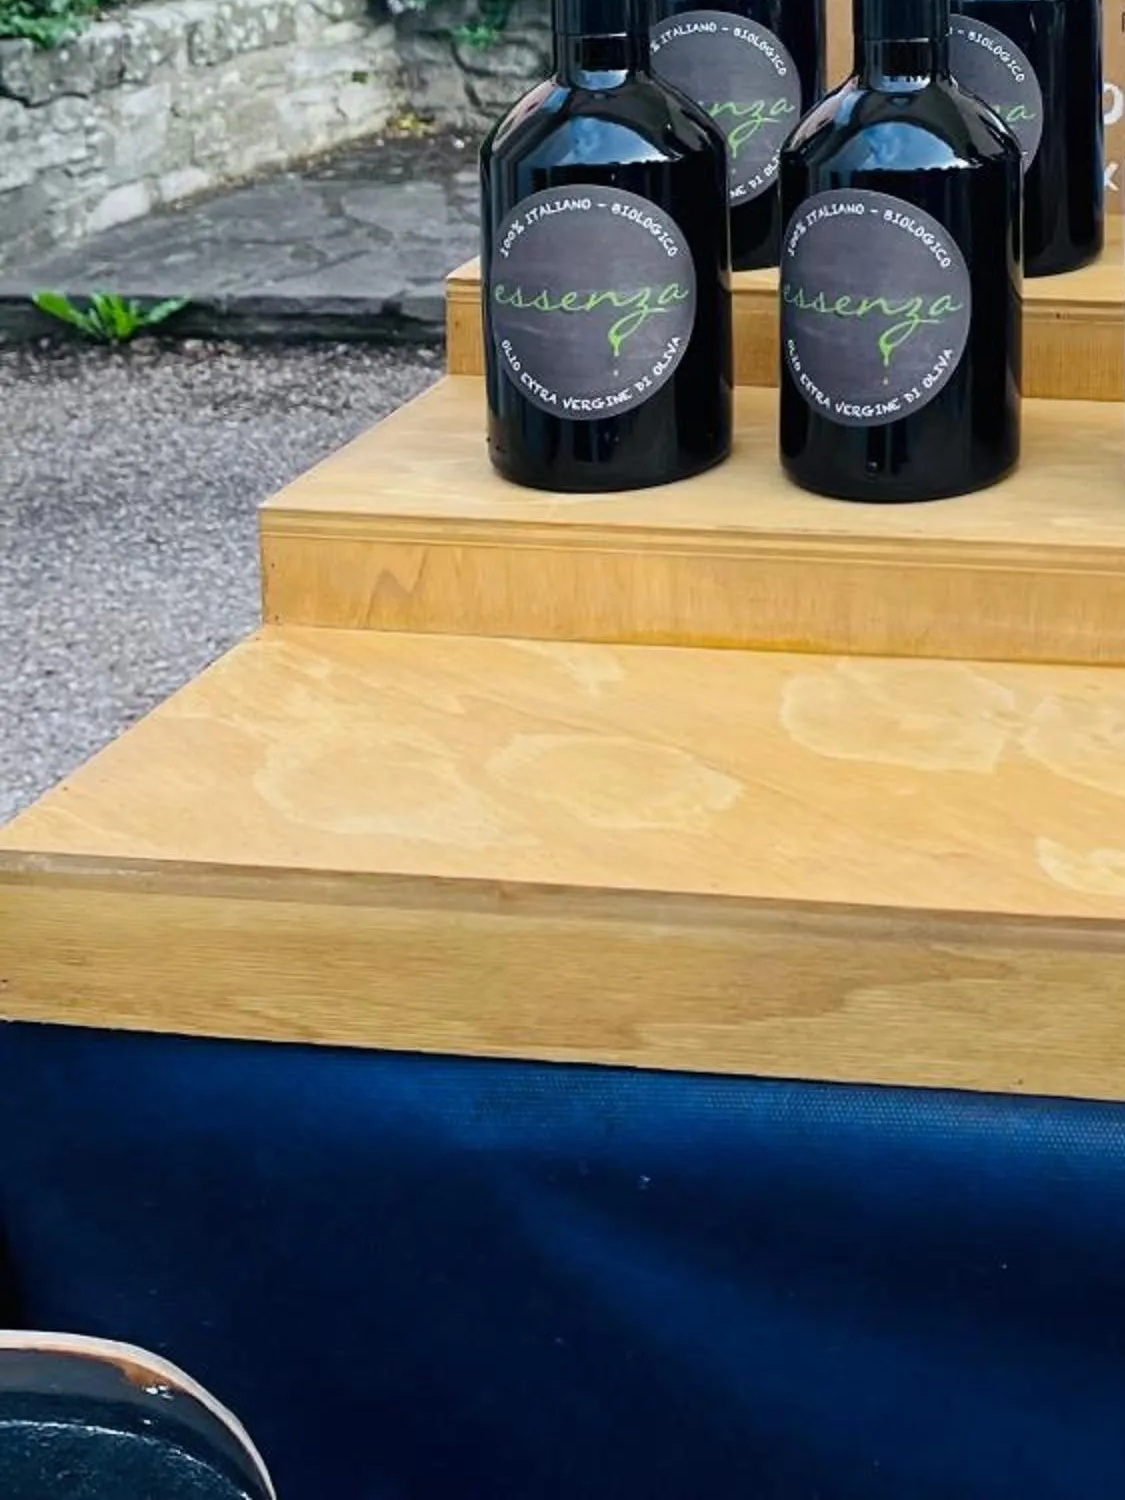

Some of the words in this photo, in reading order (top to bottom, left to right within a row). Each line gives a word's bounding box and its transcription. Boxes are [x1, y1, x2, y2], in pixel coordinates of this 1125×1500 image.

[660, 22, 717, 45] ITALIANO
[734, 27, 787, 76] BIOLOGICO
[968, 31, 1025, 83] BIOLOGICO
[500, 220, 525, 257] 100%
[525, 198, 591, 226] ITALIANO
[611, 203, 678, 257] BIOLOGICO
[806, 203, 865, 227] ITALIANO
[883, 209, 951, 269] BIOLOGICO
[494, 283, 689, 357] essenza
[784, 284, 964, 366] essenza
[501, 339, 521, 372] OLIO
[520, 372, 557, 405] EXTRA
[563, 389, 632, 411] VERGINE
[637, 375, 653, 392] DI
[653, 336, 682, 376] OLIVA
[800, 373, 831, 410] EXTRA
[835, 400, 901, 417] VERGINE
[906, 387, 921, 404] DI
[923, 349, 954, 388] OLIVA
